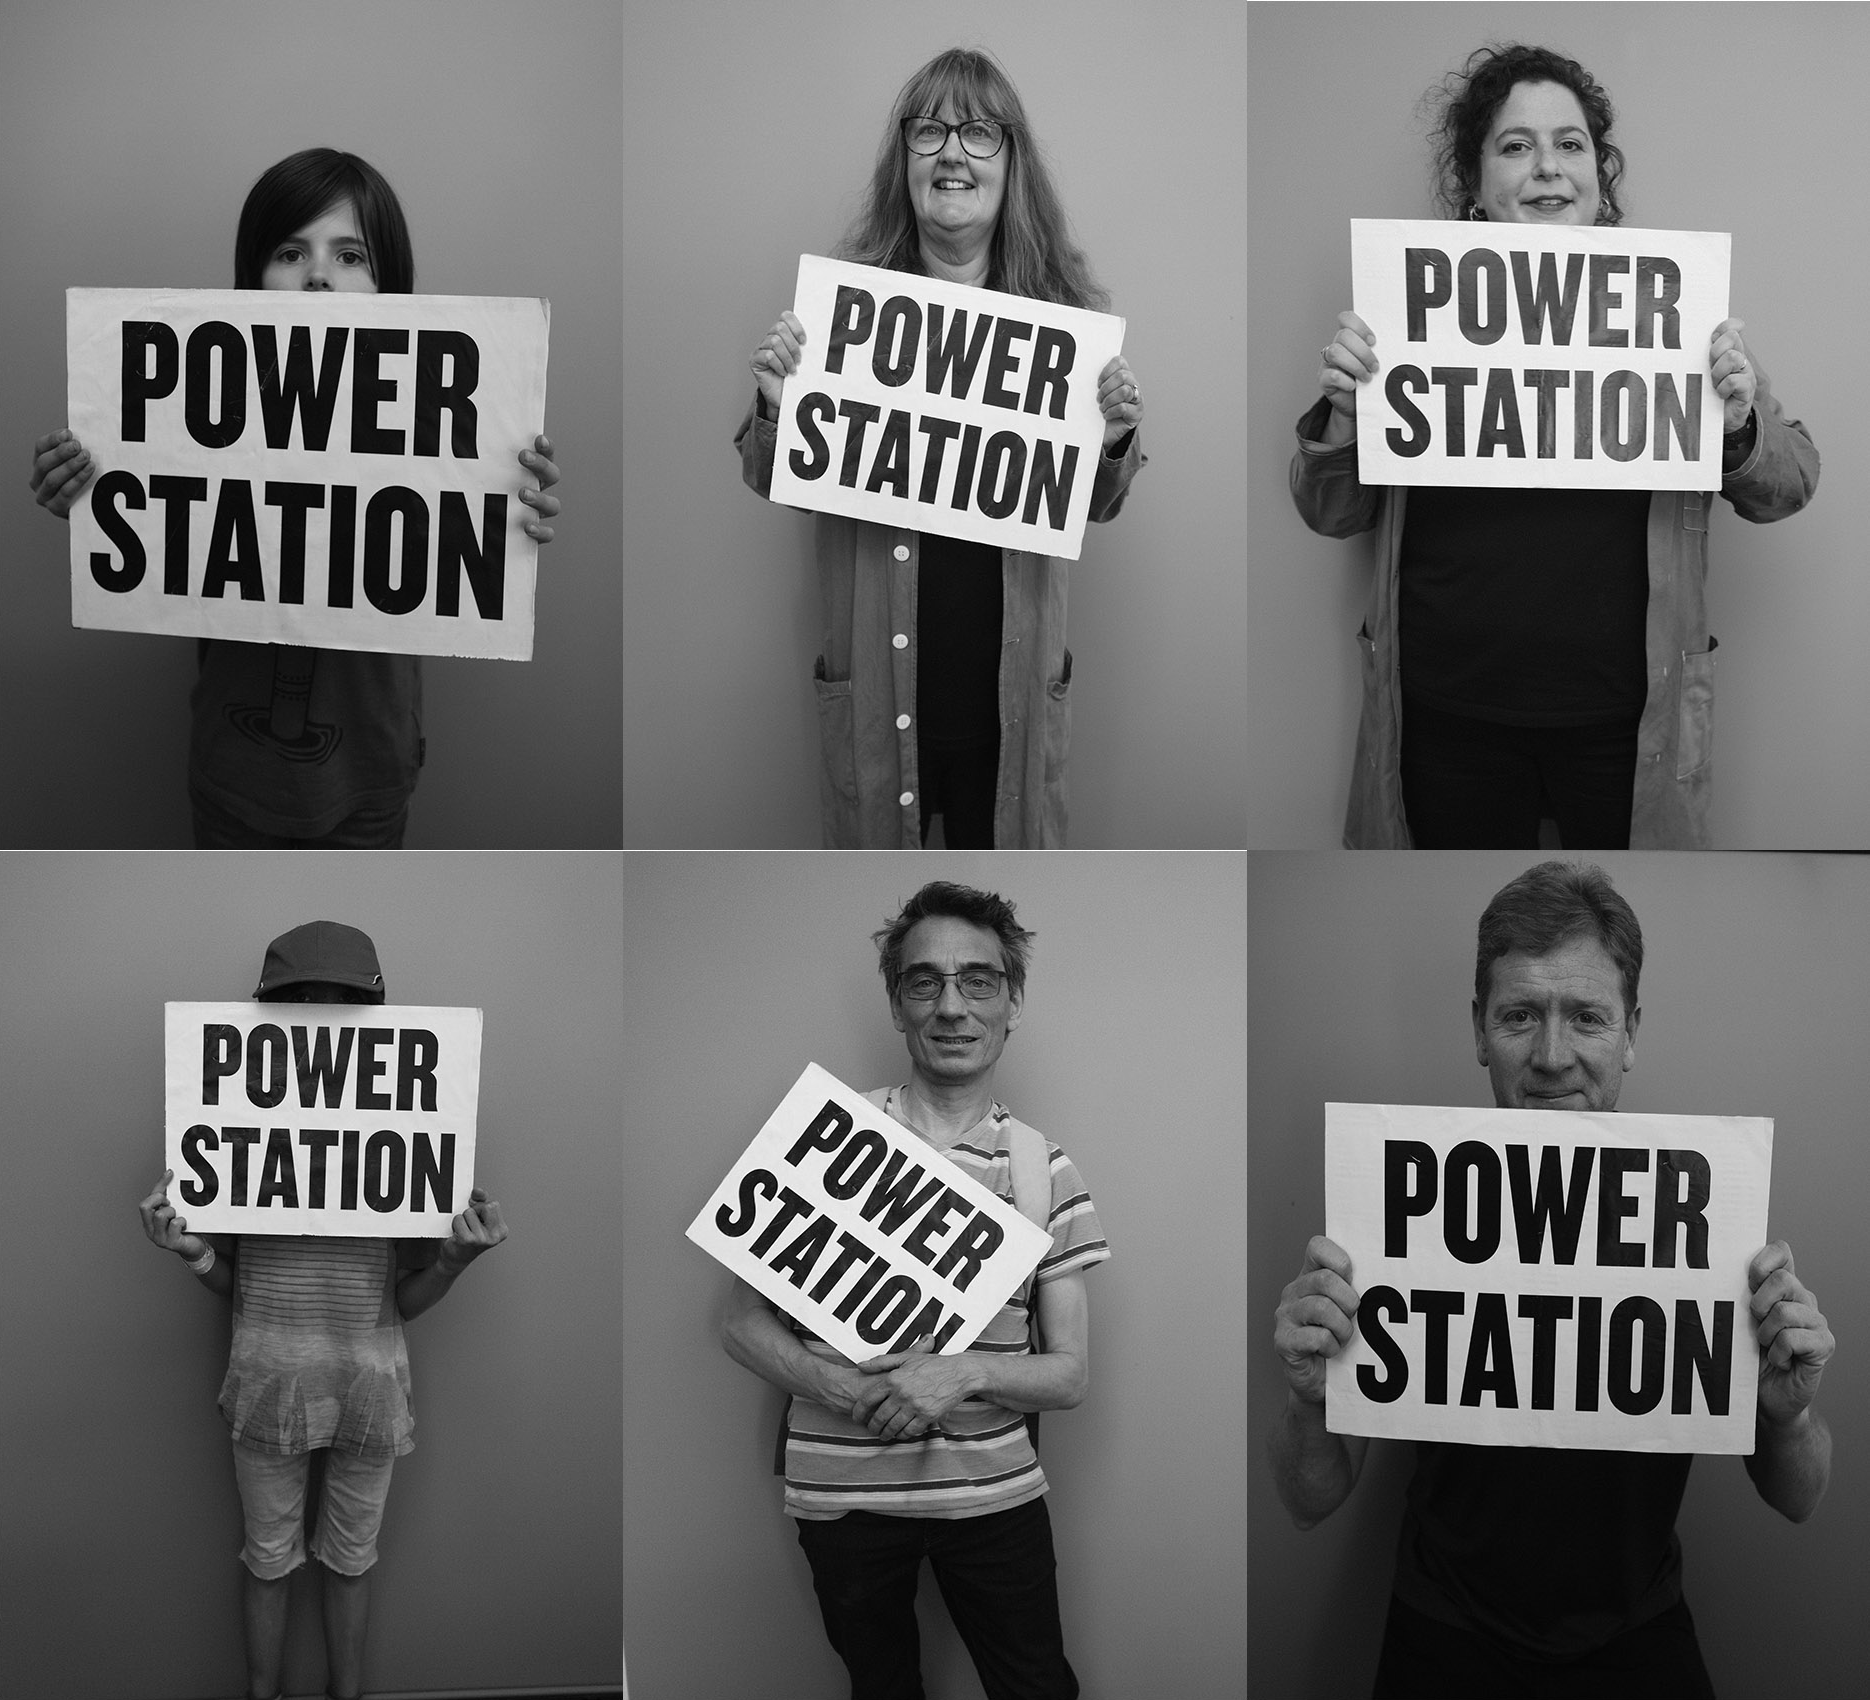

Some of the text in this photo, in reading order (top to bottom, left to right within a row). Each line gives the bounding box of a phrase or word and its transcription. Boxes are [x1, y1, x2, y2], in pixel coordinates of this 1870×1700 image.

[825, 285, 1076, 420] POWER
[1405, 248, 1681, 349] POWER
[122, 321, 479, 459] POWER
[1385, 364, 1702, 462] STATION
[789, 392, 1079, 531] STATION
[90, 470, 508, 620] STATION
[203, 1024, 438, 1112] POWER
[180, 1125, 455, 1213] STATION
[784, 1099, 1004, 1294] POWER
[1385, 1140, 1711, 1269] POWER
[715, 1168, 964, 1355] STATION
[1355, 1284, 1735, 1416] STATION
